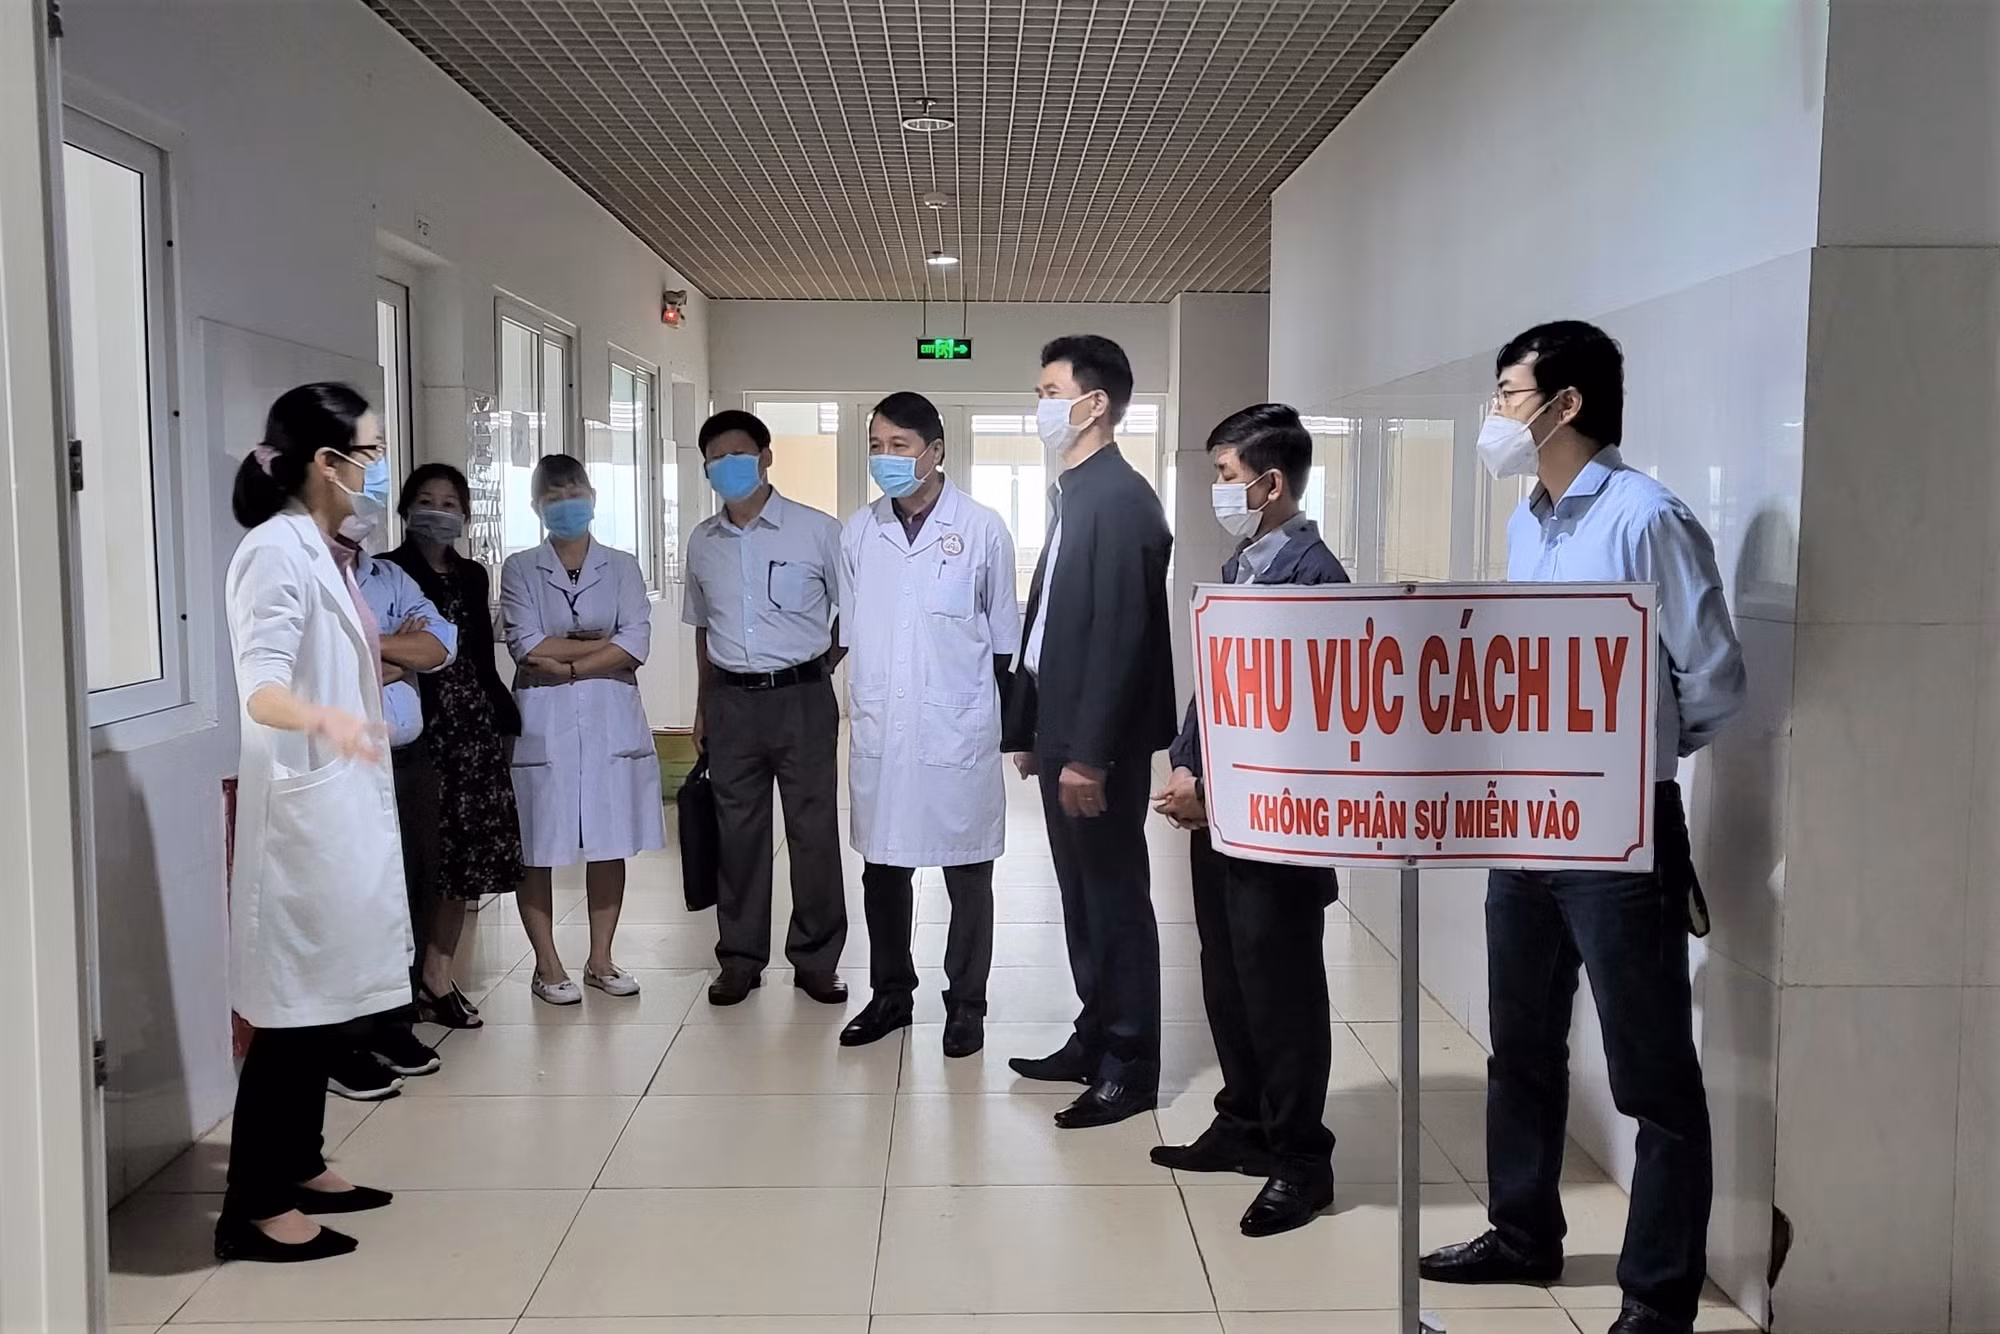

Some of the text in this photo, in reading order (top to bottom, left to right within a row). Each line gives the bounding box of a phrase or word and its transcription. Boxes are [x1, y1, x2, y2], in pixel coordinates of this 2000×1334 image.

[920, 344, 934, 353] EXIT
[1208, 608, 1629, 762] KHU VỰC CÁCH LY
[1249, 780, 1580, 851] KHÔNG PHẬN SỰ MIỄN VÀO
